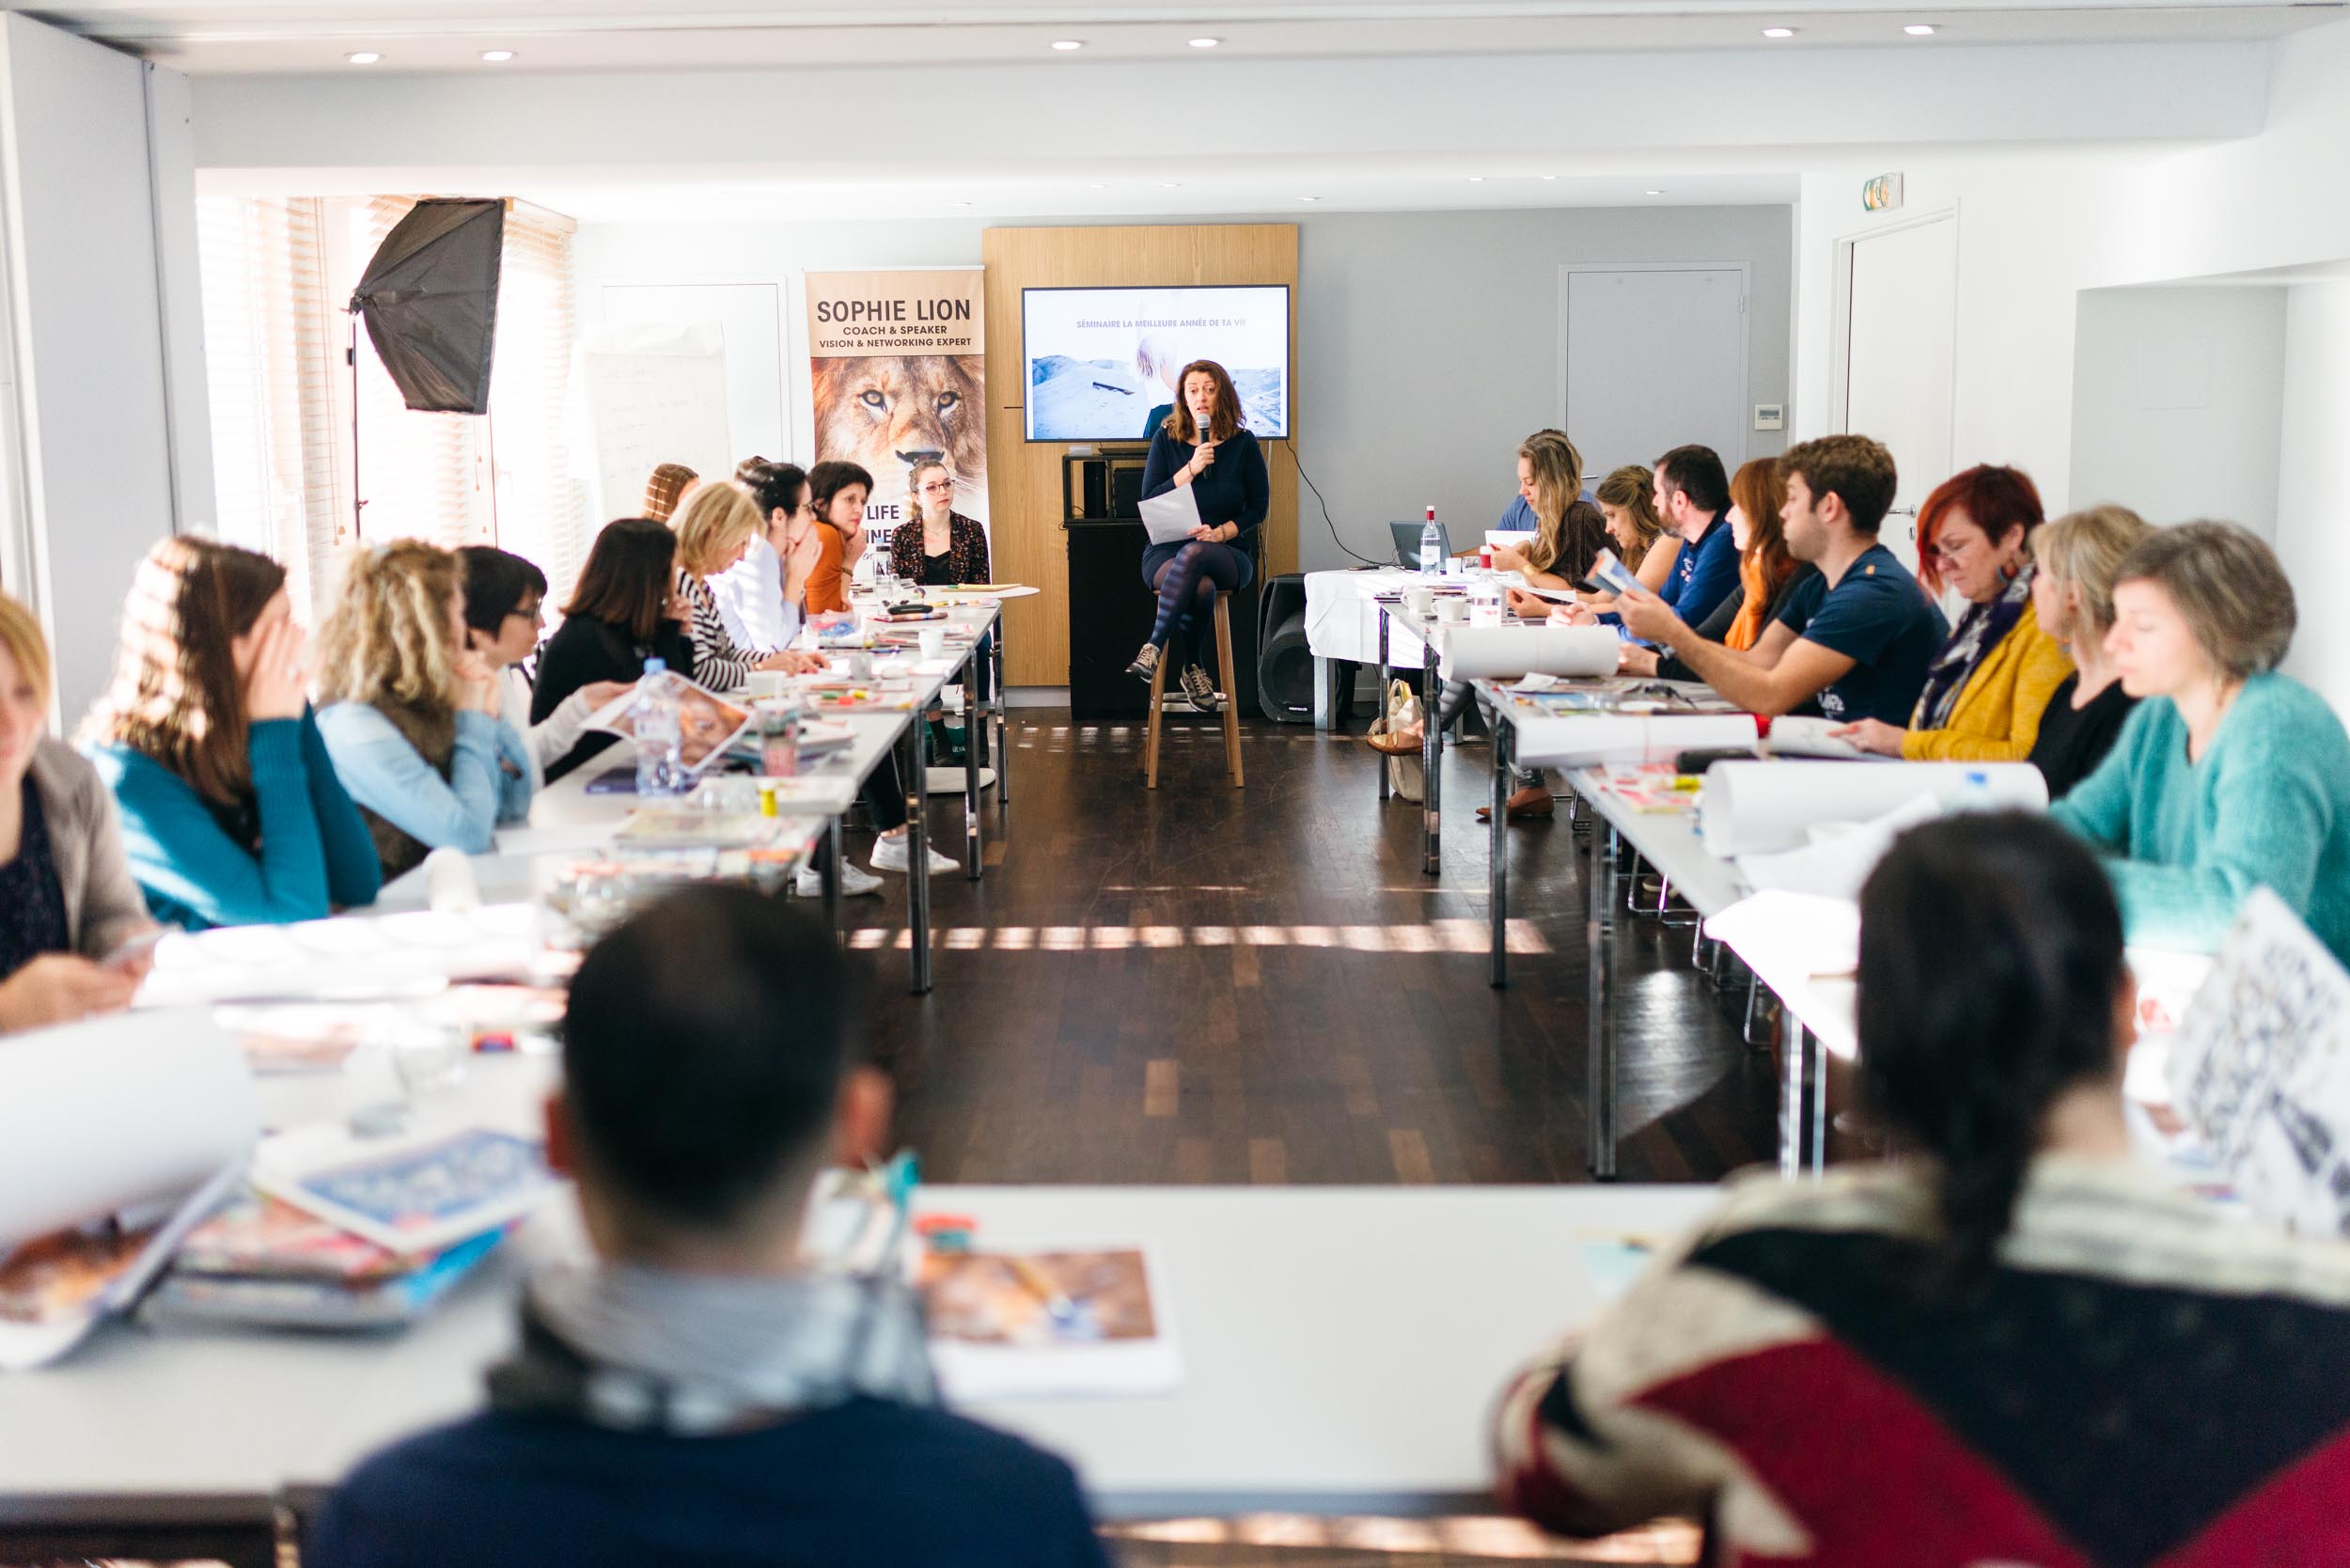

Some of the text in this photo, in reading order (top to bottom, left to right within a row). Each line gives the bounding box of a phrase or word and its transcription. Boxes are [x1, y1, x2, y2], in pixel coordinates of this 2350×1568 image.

[818, 299, 971, 322] SOPHIE LION
[1076, 318, 1120, 328] SÉMINAIRE
[1122, 320, 1133, 328] LA
[1179, 317, 1207, 327] ANNÉE
[1209, 319, 1219, 327] DE
[1221, 319, 1231, 327] TA
[843, 325, 948, 336] COACH & SPEAKER
[820, 337, 972, 348] VISION & NETWORKING EXPERT
[867, 505, 900, 520] LIFE
